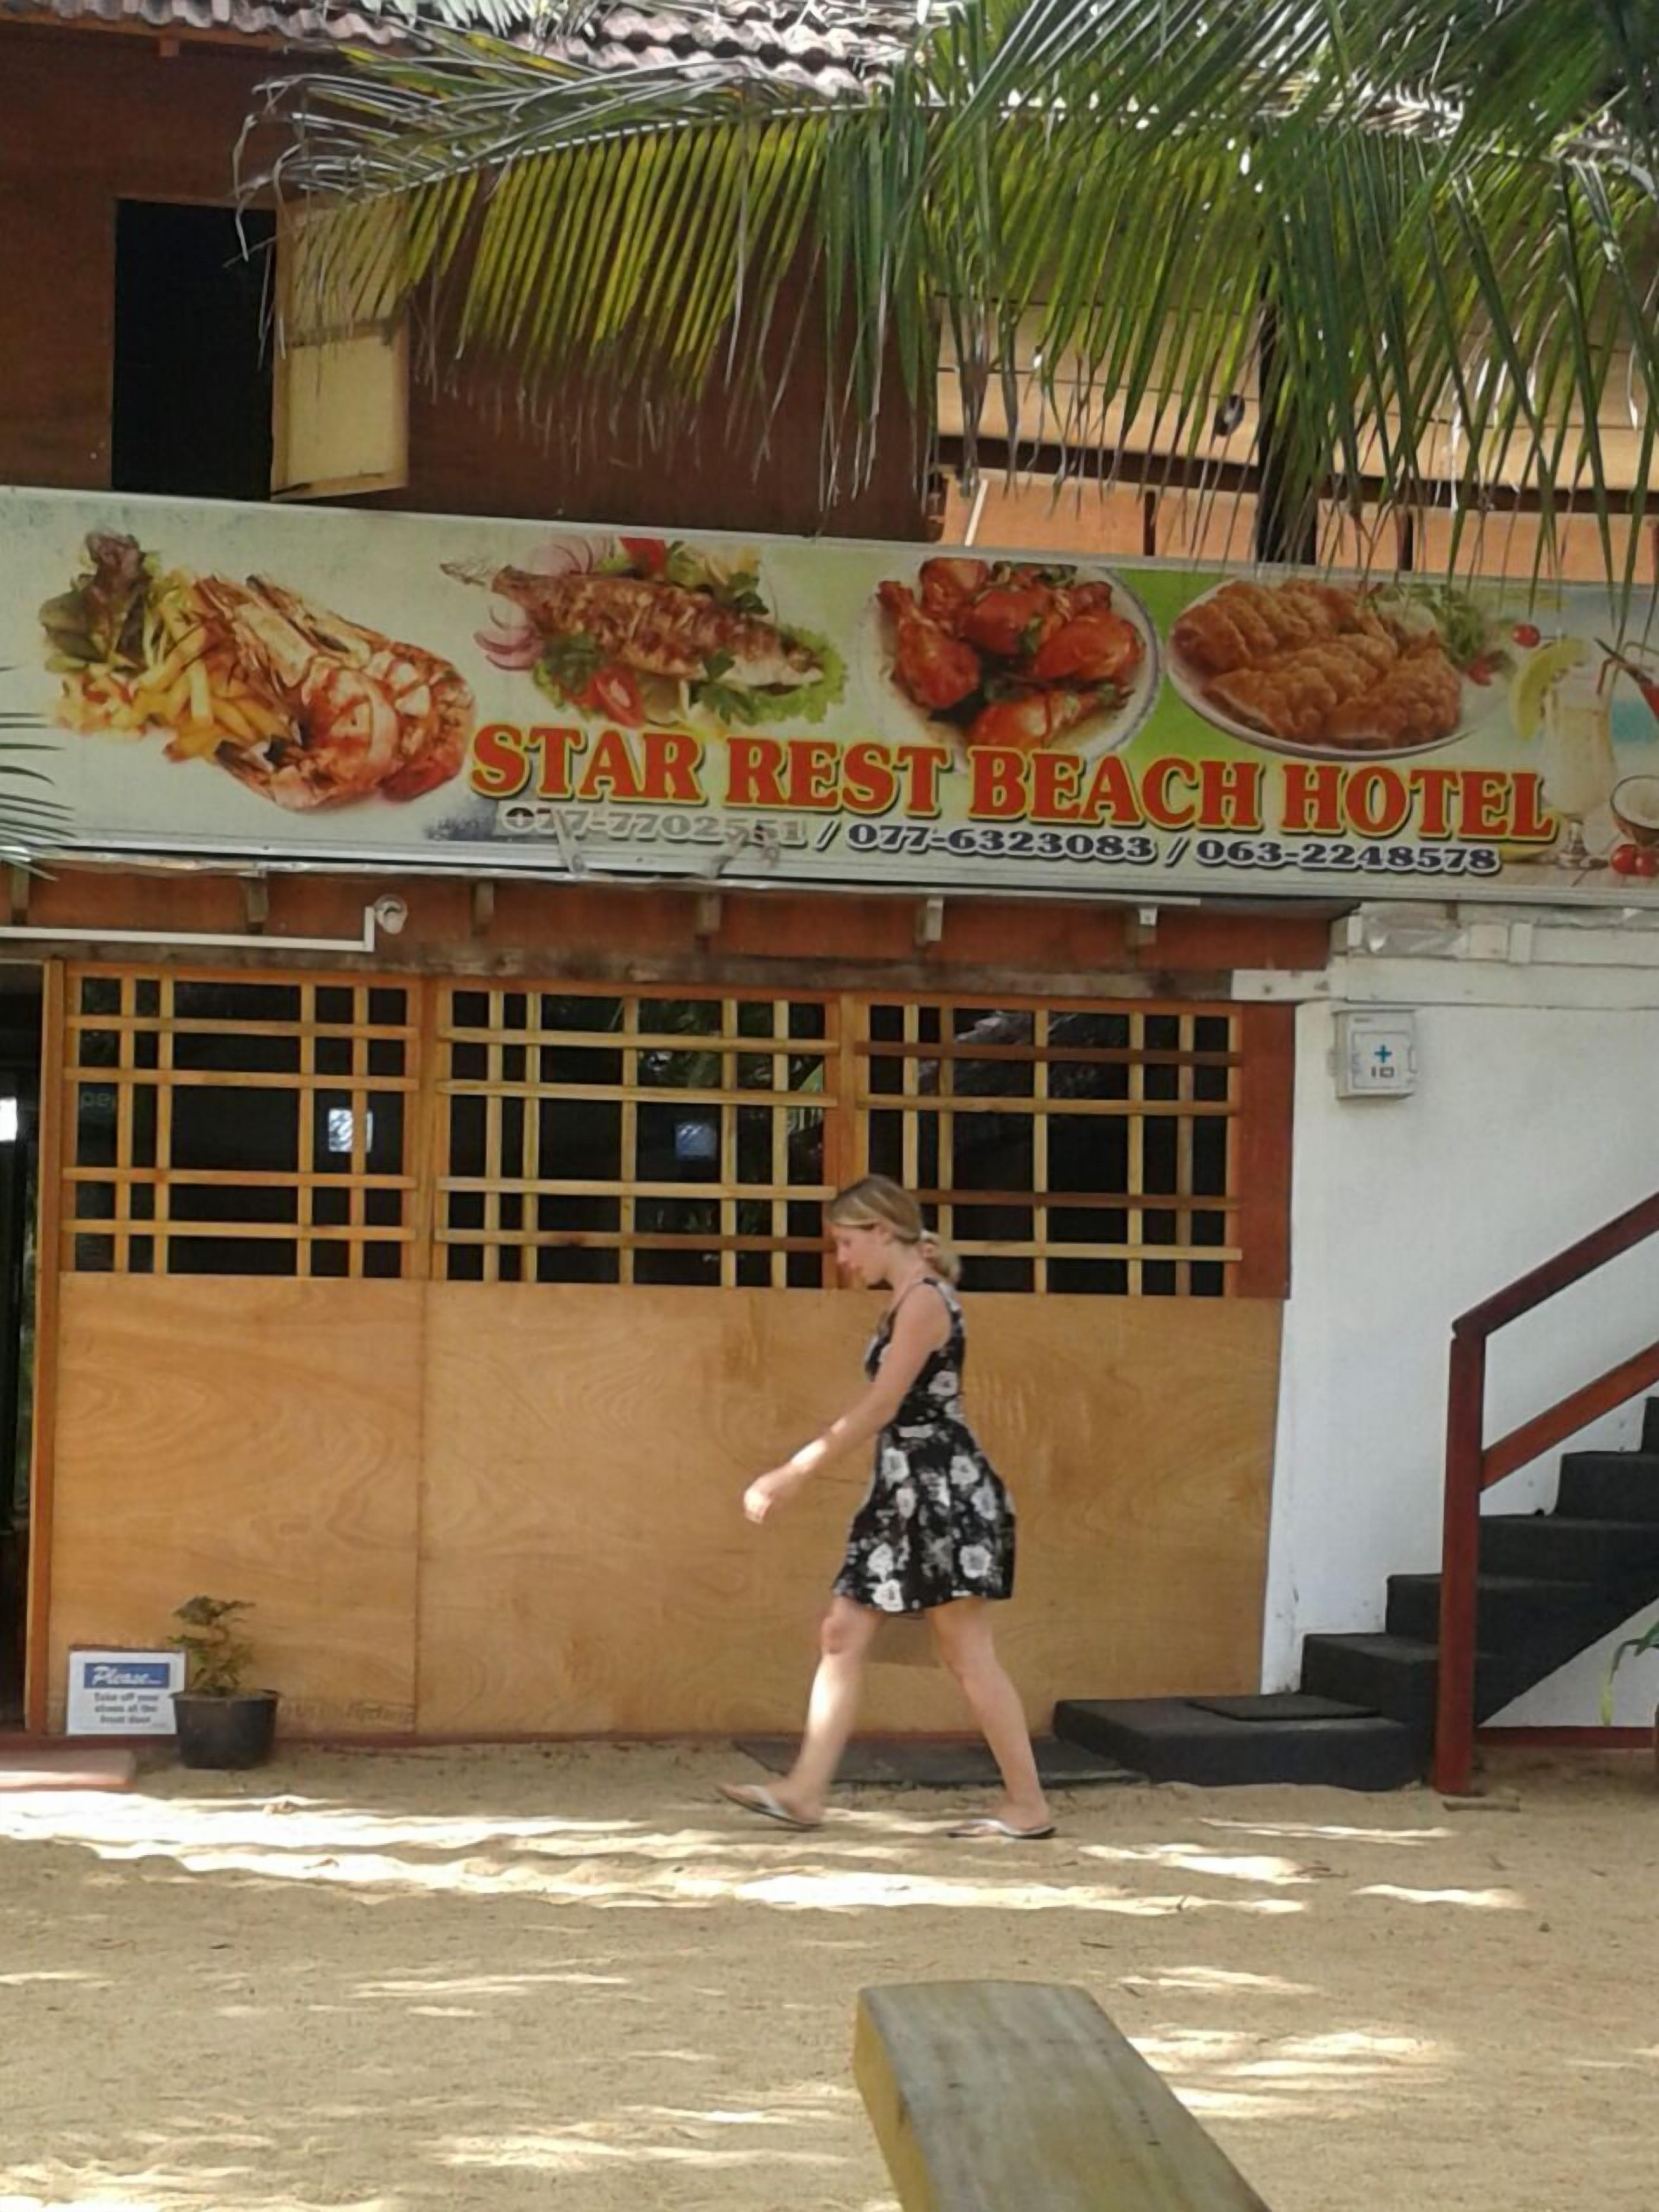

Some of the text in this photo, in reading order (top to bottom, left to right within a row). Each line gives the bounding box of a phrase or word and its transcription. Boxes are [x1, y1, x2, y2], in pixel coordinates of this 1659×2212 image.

[470, 722, 1558, 840] STAR REST BEACH HOTEL
[848, 823, 1156, 862] 077-6323083
[1197, 838, 1502, 874] 063-2248578
